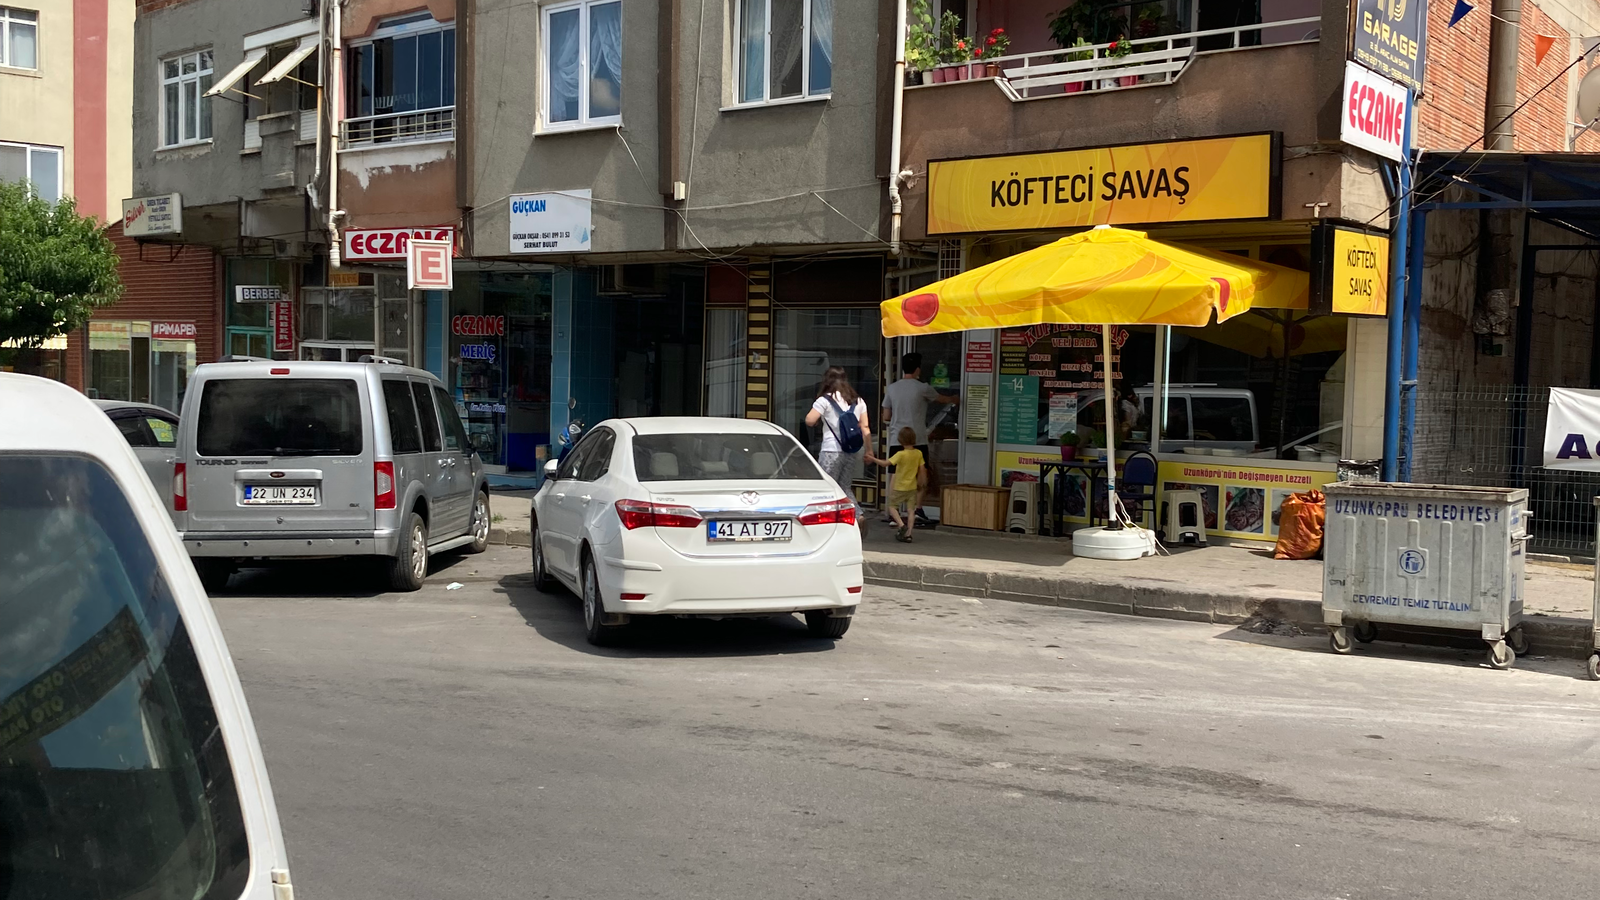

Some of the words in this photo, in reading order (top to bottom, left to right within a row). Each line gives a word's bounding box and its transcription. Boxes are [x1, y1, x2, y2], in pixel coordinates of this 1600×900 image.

[1363, 10, 1418, 61] GARAGE
[1349, 80, 1404, 146] ECZANE
[991, 166, 1093, 208] KÖFTECİ
[1101, 166, 1190, 205] SAVAŞ
[512, 198, 546, 216] GÜÇKAN
[421, 250, 442, 280] E
[1347, 244, 1377, 269] KÖFTECİ
[243, 288, 280, 299] BERBER
[1349, 278, 1372, 302] SAVAŞ
[160, 323, 197, 335] PİMAPEN
[279, 302, 289, 340] BERBER
[452, 315, 504, 336] ECZANE
[1052, 336, 1072, 347] VELİ
[1073, 338, 1097, 348] BABA
[460, 342, 496, 363] MERİÇ
[1029, 353, 1051, 362] KÖFTE
[1095, 353, 1120, 362] BİEK
[1081, 362, 1093, 372] ŞİŞ
[1012, 378, 1024, 391] 14
[1184, 468, 1236, 479] Uzunköprü'nün
[1239, 471, 1283, 482] Değişmeyen
[1286, 474, 1312, 484] Lezzeti
[253, 488, 266, 499] 22
[273, 488, 286, 499] UN
[292, 488, 313, 499] 234
[718, 523, 734, 536] 41
[740, 523, 759, 536] AT
[764, 522, 788, 536] 977
[1403, 597, 1430, 608] TEMİZ
[1432, 600, 1472, 612] TUTALIM
